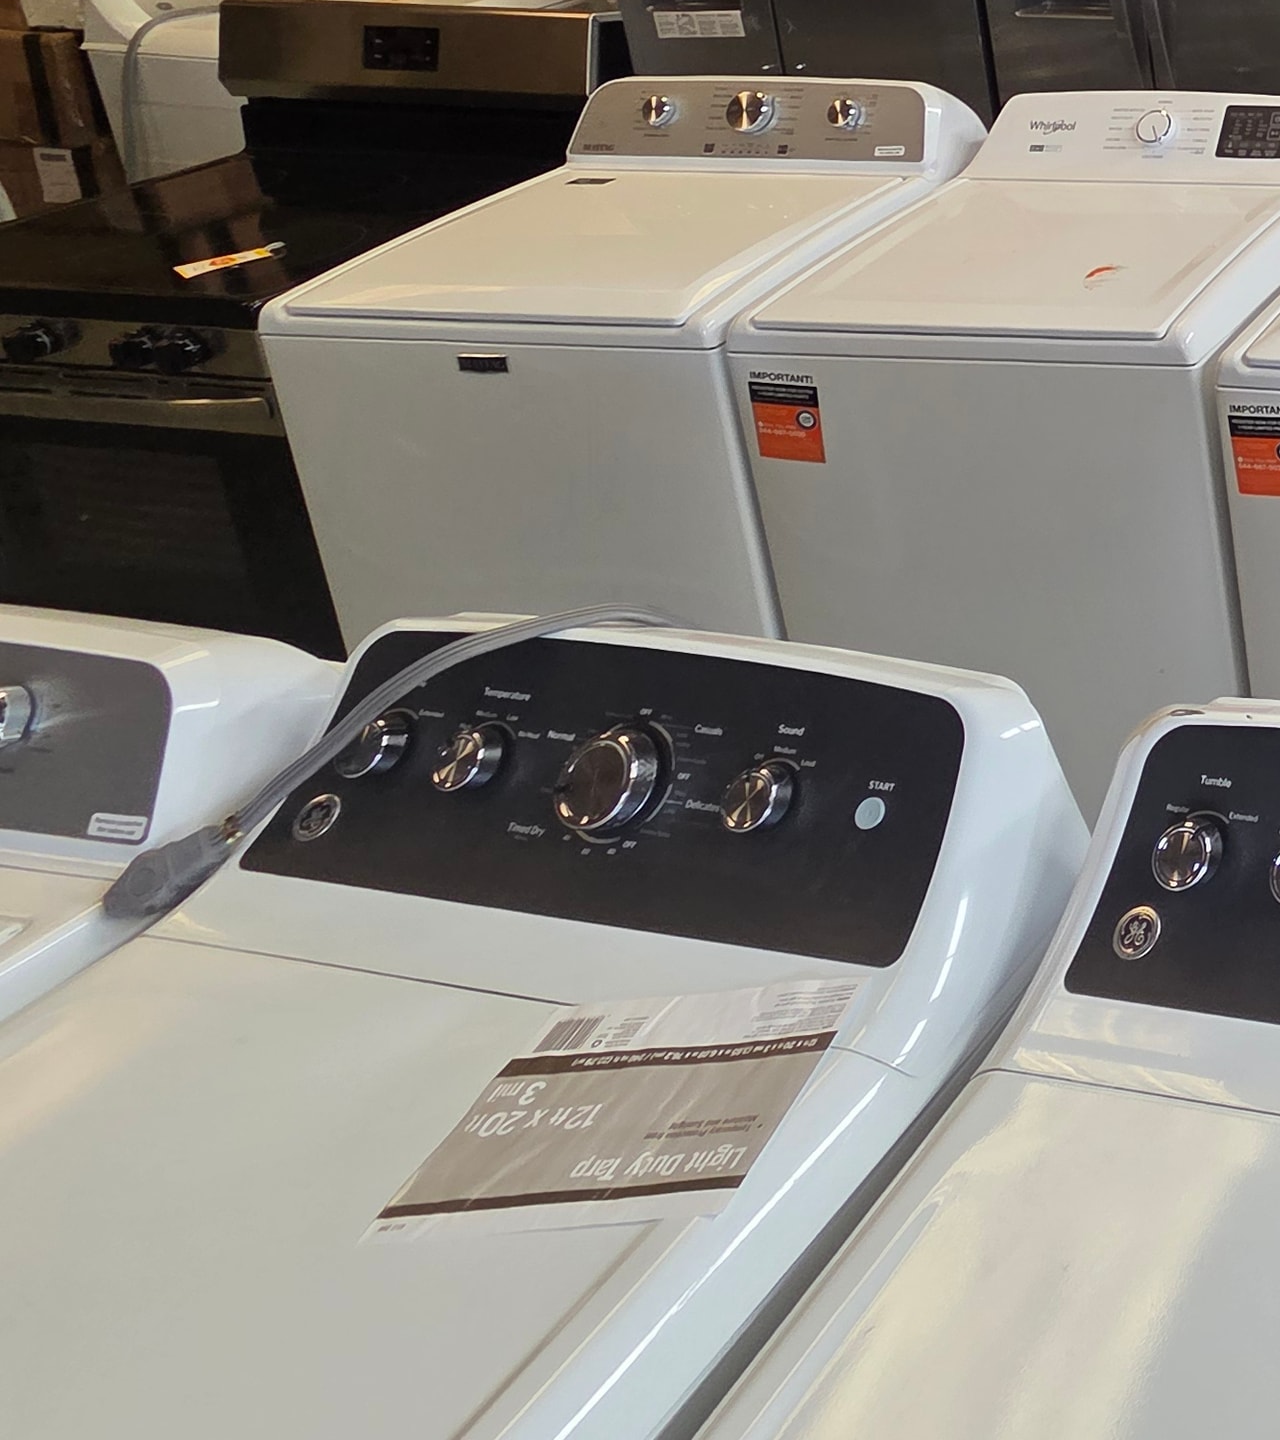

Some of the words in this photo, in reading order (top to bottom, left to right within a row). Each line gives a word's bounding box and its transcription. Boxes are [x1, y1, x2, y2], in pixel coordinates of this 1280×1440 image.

[1030, 119, 1077, 135] Whirlpool
[750, 371, 813, 385] IMPORTANT!
[547, 730, 576, 741] Normal
[778, 724, 805, 737] Sound
[868, 780, 895, 791] START
[1200, 775, 1232, 788] Tumble
[1228, 811, 1258, 822] Extended
[487, 1081, 526, 1103] mil
[519, 1080, 547, 1105] 3
[523, 1108, 549, 1128] x
[624, 1150, 685, 1177] Duty
[683, 1143, 748, 1173] Light
[570, 1154, 622, 1182] Tarp
